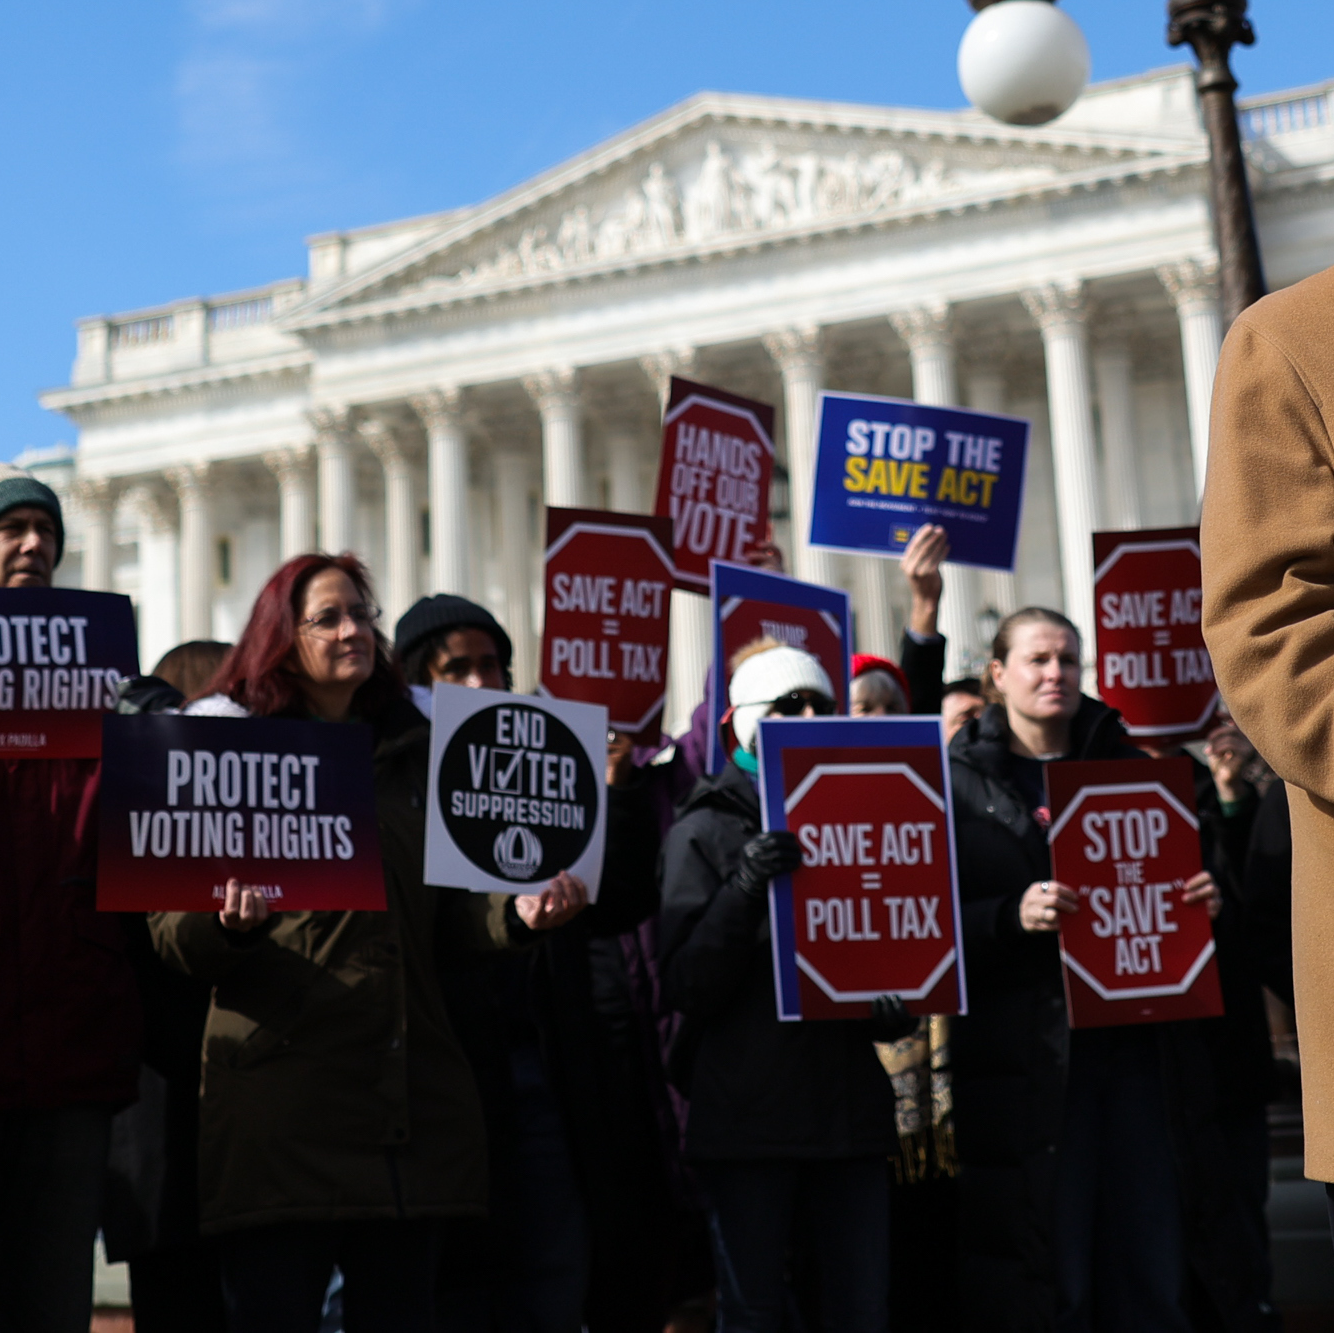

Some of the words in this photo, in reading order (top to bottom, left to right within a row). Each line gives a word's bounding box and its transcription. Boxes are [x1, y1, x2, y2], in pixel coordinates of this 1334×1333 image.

[676, 421, 762, 484] HANDS
[845, 418, 936, 461] STOP
[944, 430, 1003, 472] THE
[670, 462, 715, 501] OFF
[716, 474, 759, 514] OUR
[843, 455, 930, 498] SAVE
[936, 466, 999, 509] ACT
[669, 496, 757, 562] VOTE
[552, 571, 616, 614] SAVE
[620, 578, 665, 619] ACT
[1101, 590, 1166, 630] SAVE
[1169, 587, 1202, 625] AC
[551, 637, 615, 678] POLL
[620, 642, 662, 683] TAX
[1103, 651, 1169, 688] POLL
[22, 668, 121, 711] RIGHTS
[496, 708, 546, 749] END
[167, 749, 319, 810] PROTECT
[451, 790, 585, 830] SUPPRESSION
[129, 811, 244, 858] VOTING
[252, 812, 355, 860] RIGHTS
[798, 823, 875, 867] SAVE
[881, 822, 936, 865] ACT
[1081, 808, 1168, 862] STOP
[1114, 861, 1145, 884] THE
[805, 897, 881, 942] POLL
[883, 896, 942, 940] TAX
[1079, 878, 1185, 938] "SAVE"
[1115, 935, 1162, 975] ACT
